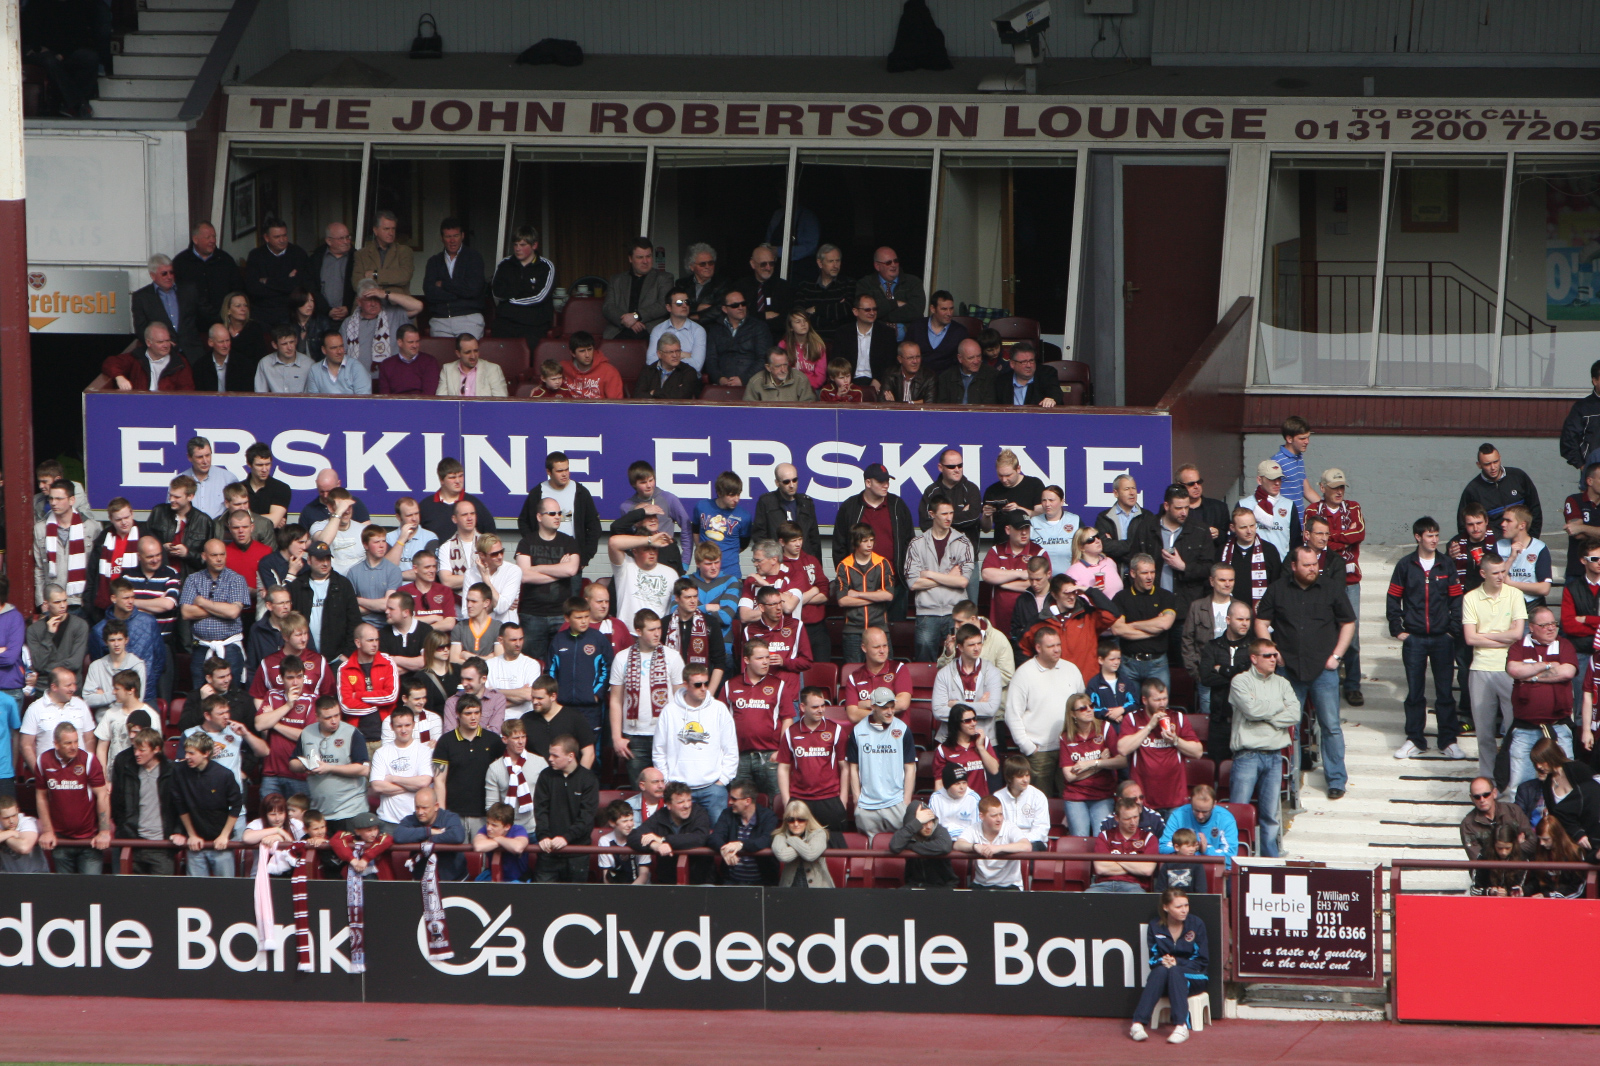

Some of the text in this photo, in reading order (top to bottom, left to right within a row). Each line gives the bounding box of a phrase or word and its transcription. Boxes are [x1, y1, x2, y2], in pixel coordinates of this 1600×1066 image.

[250, 97, 1267, 139] THE JOHN ROBERTSON LOUNGE
[1352, 108, 1548, 120] TO BOOK CALL
[1294, 119, 1600, 141] 0131 200 7205
[30, 290, 117, 315] refresh!
[117, 424, 1145, 508] ERSKINE ERSKINE
[1316, 890, 1360, 902] 7 William St
[1252, 897, 1306, 913] Herbie
[1316, 901, 1350, 912] EH3 7NG
[1316, 911, 1343, 926] 0131
[1249, 928, 1309, 938] WEST END
[1316, 925, 1367, 940] 226 6366
[177, 907, 363, 974] Bank
[542, 912, 1149, 994] Clydesdale Ban
[1275, 946, 1305, 957] taste
[1307, 947, 1321, 961] of
[1324, 948, 1368, 961] quality
[1261, 957, 1351, 971] in the west end
